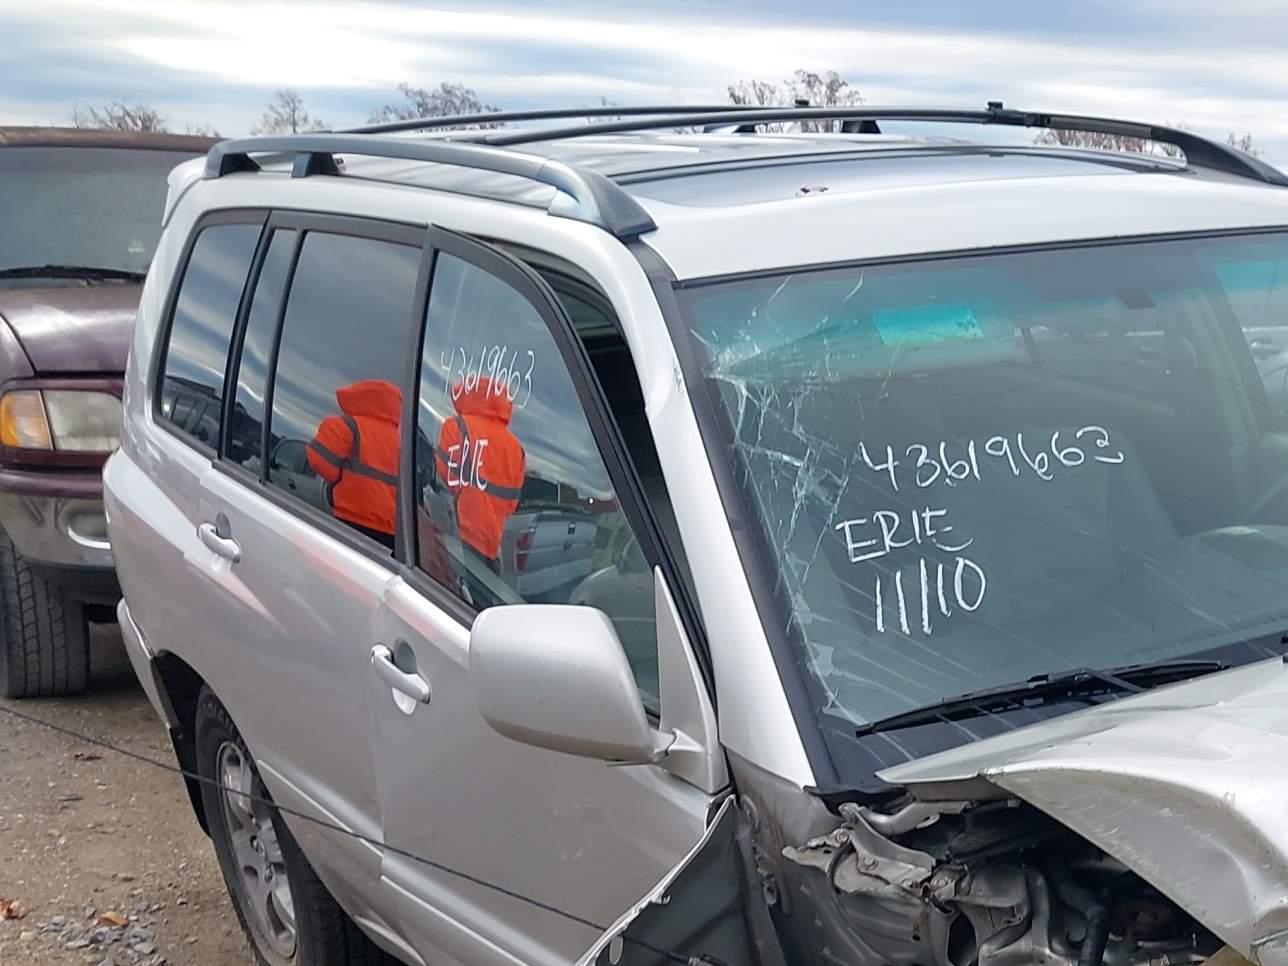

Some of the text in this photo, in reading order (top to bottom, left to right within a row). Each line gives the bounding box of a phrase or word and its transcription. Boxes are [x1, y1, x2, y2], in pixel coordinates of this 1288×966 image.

[441, 345, 534, 408] 43619663
[859, 426, 1124, 491] 43619663
[835, 507, 973, 562] ERIE
